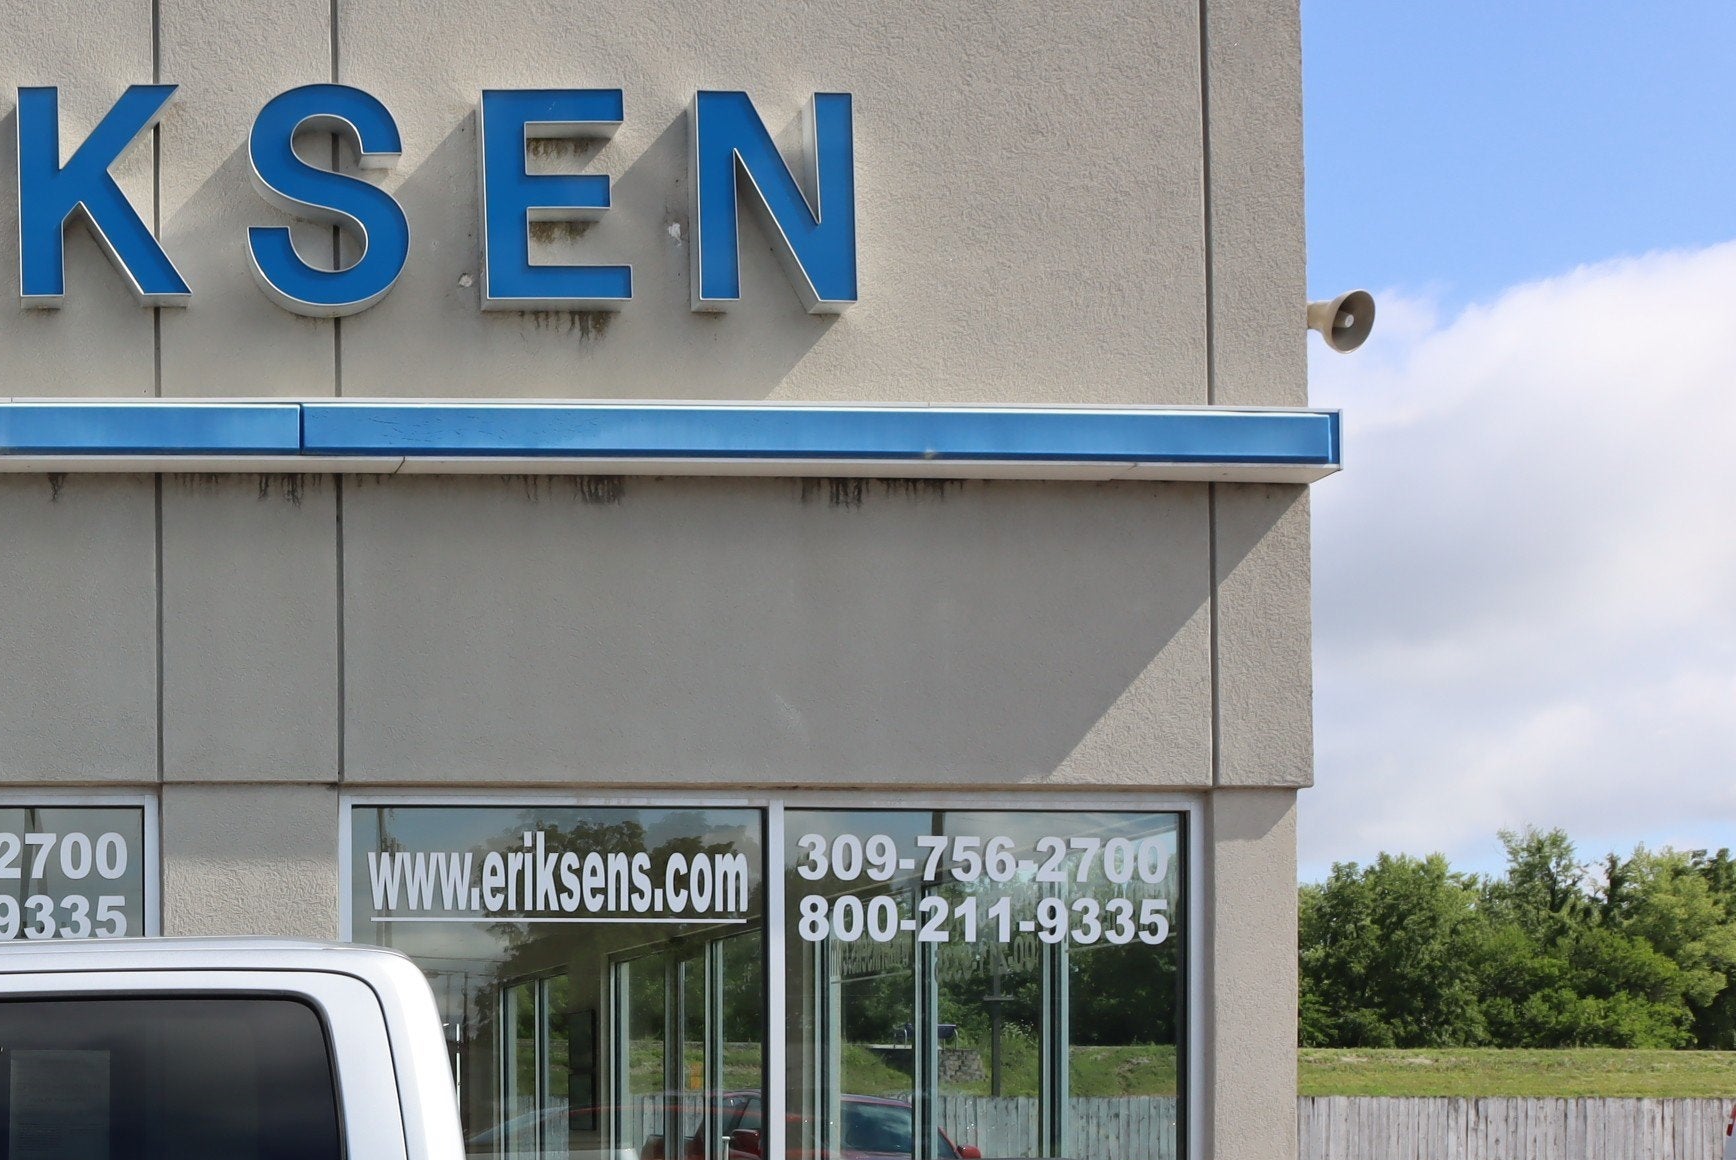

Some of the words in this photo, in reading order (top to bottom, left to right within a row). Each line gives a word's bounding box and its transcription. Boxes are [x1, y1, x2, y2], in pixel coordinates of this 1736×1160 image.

[368, 831, 748, 912] www.eriksens.com
[797, 833, 1170, 887] 309-756-2700
[798, 894, 1170, 946] 800-211-9335
